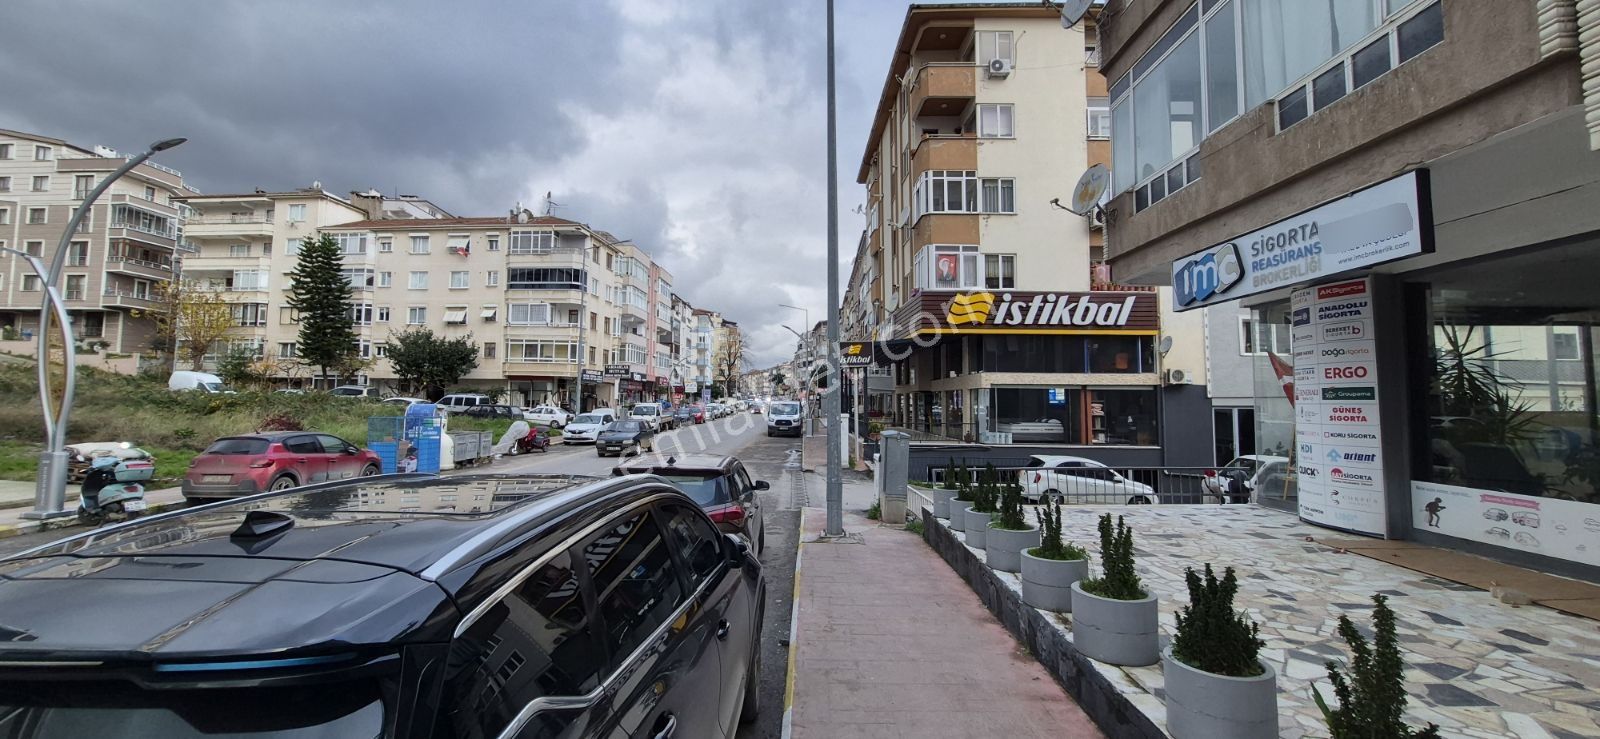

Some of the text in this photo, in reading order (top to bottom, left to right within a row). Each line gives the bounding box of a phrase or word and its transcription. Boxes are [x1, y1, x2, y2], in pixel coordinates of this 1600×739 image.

[1251, 221, 1319, 258] SİGORTA
[1251, 241, 1322, 273] REASÜRANS
[993, 293, 1136, 326] istikbal
[1318, 301, 1367, 312] ANADOLU
[1318, 309, 1361, 321] SİGORTA
[1324, 366, 1368, 379] ERGO
[1332, 405, 1362, 414] GÜNEŞ
[1344, 453, 1376, 462] orient
